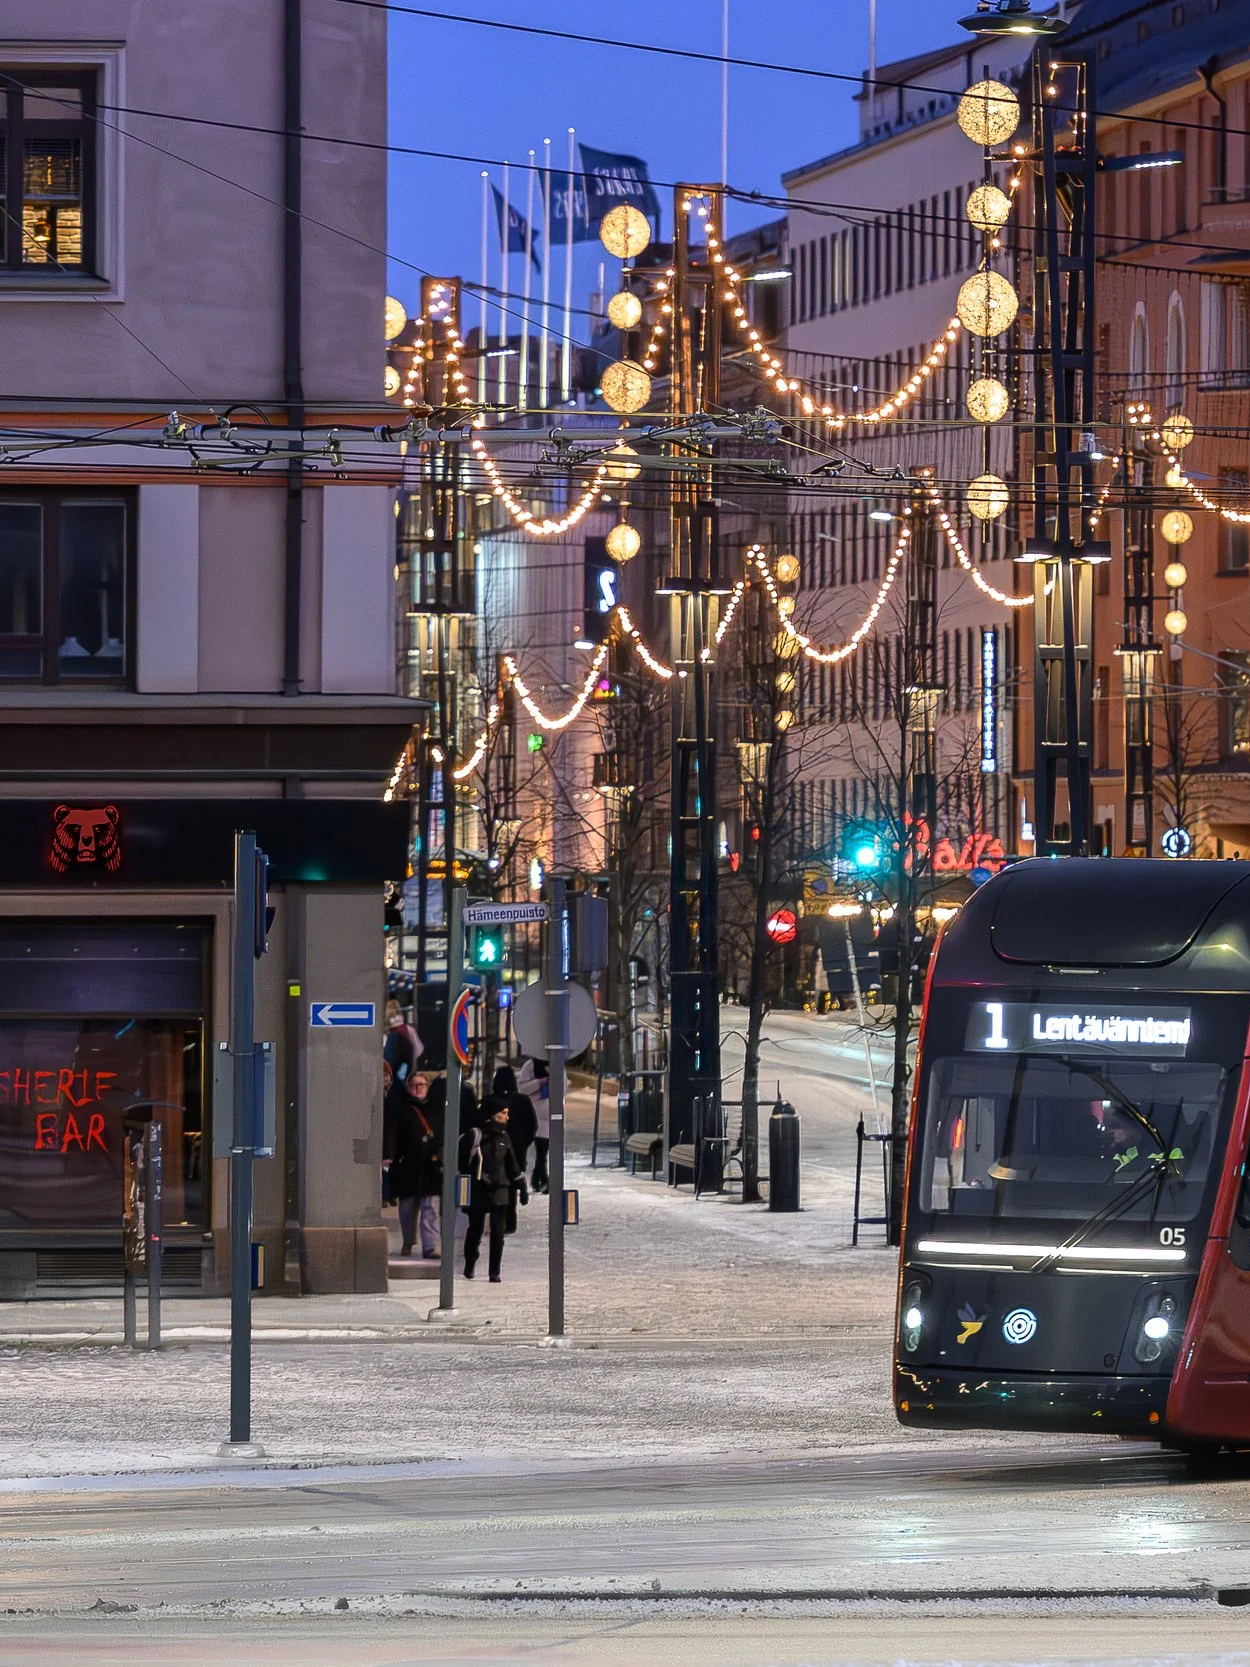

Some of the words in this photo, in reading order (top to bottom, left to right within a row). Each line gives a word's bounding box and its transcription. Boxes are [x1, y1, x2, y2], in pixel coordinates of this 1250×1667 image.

[468, 906, 545, 921] Hämeenpuisto
[985, 1002, 1008, 1048] 1
[1033, 1013, 1191, 1044] Lentävänniemi
[1160, 1227, 1186, 1246] 05
